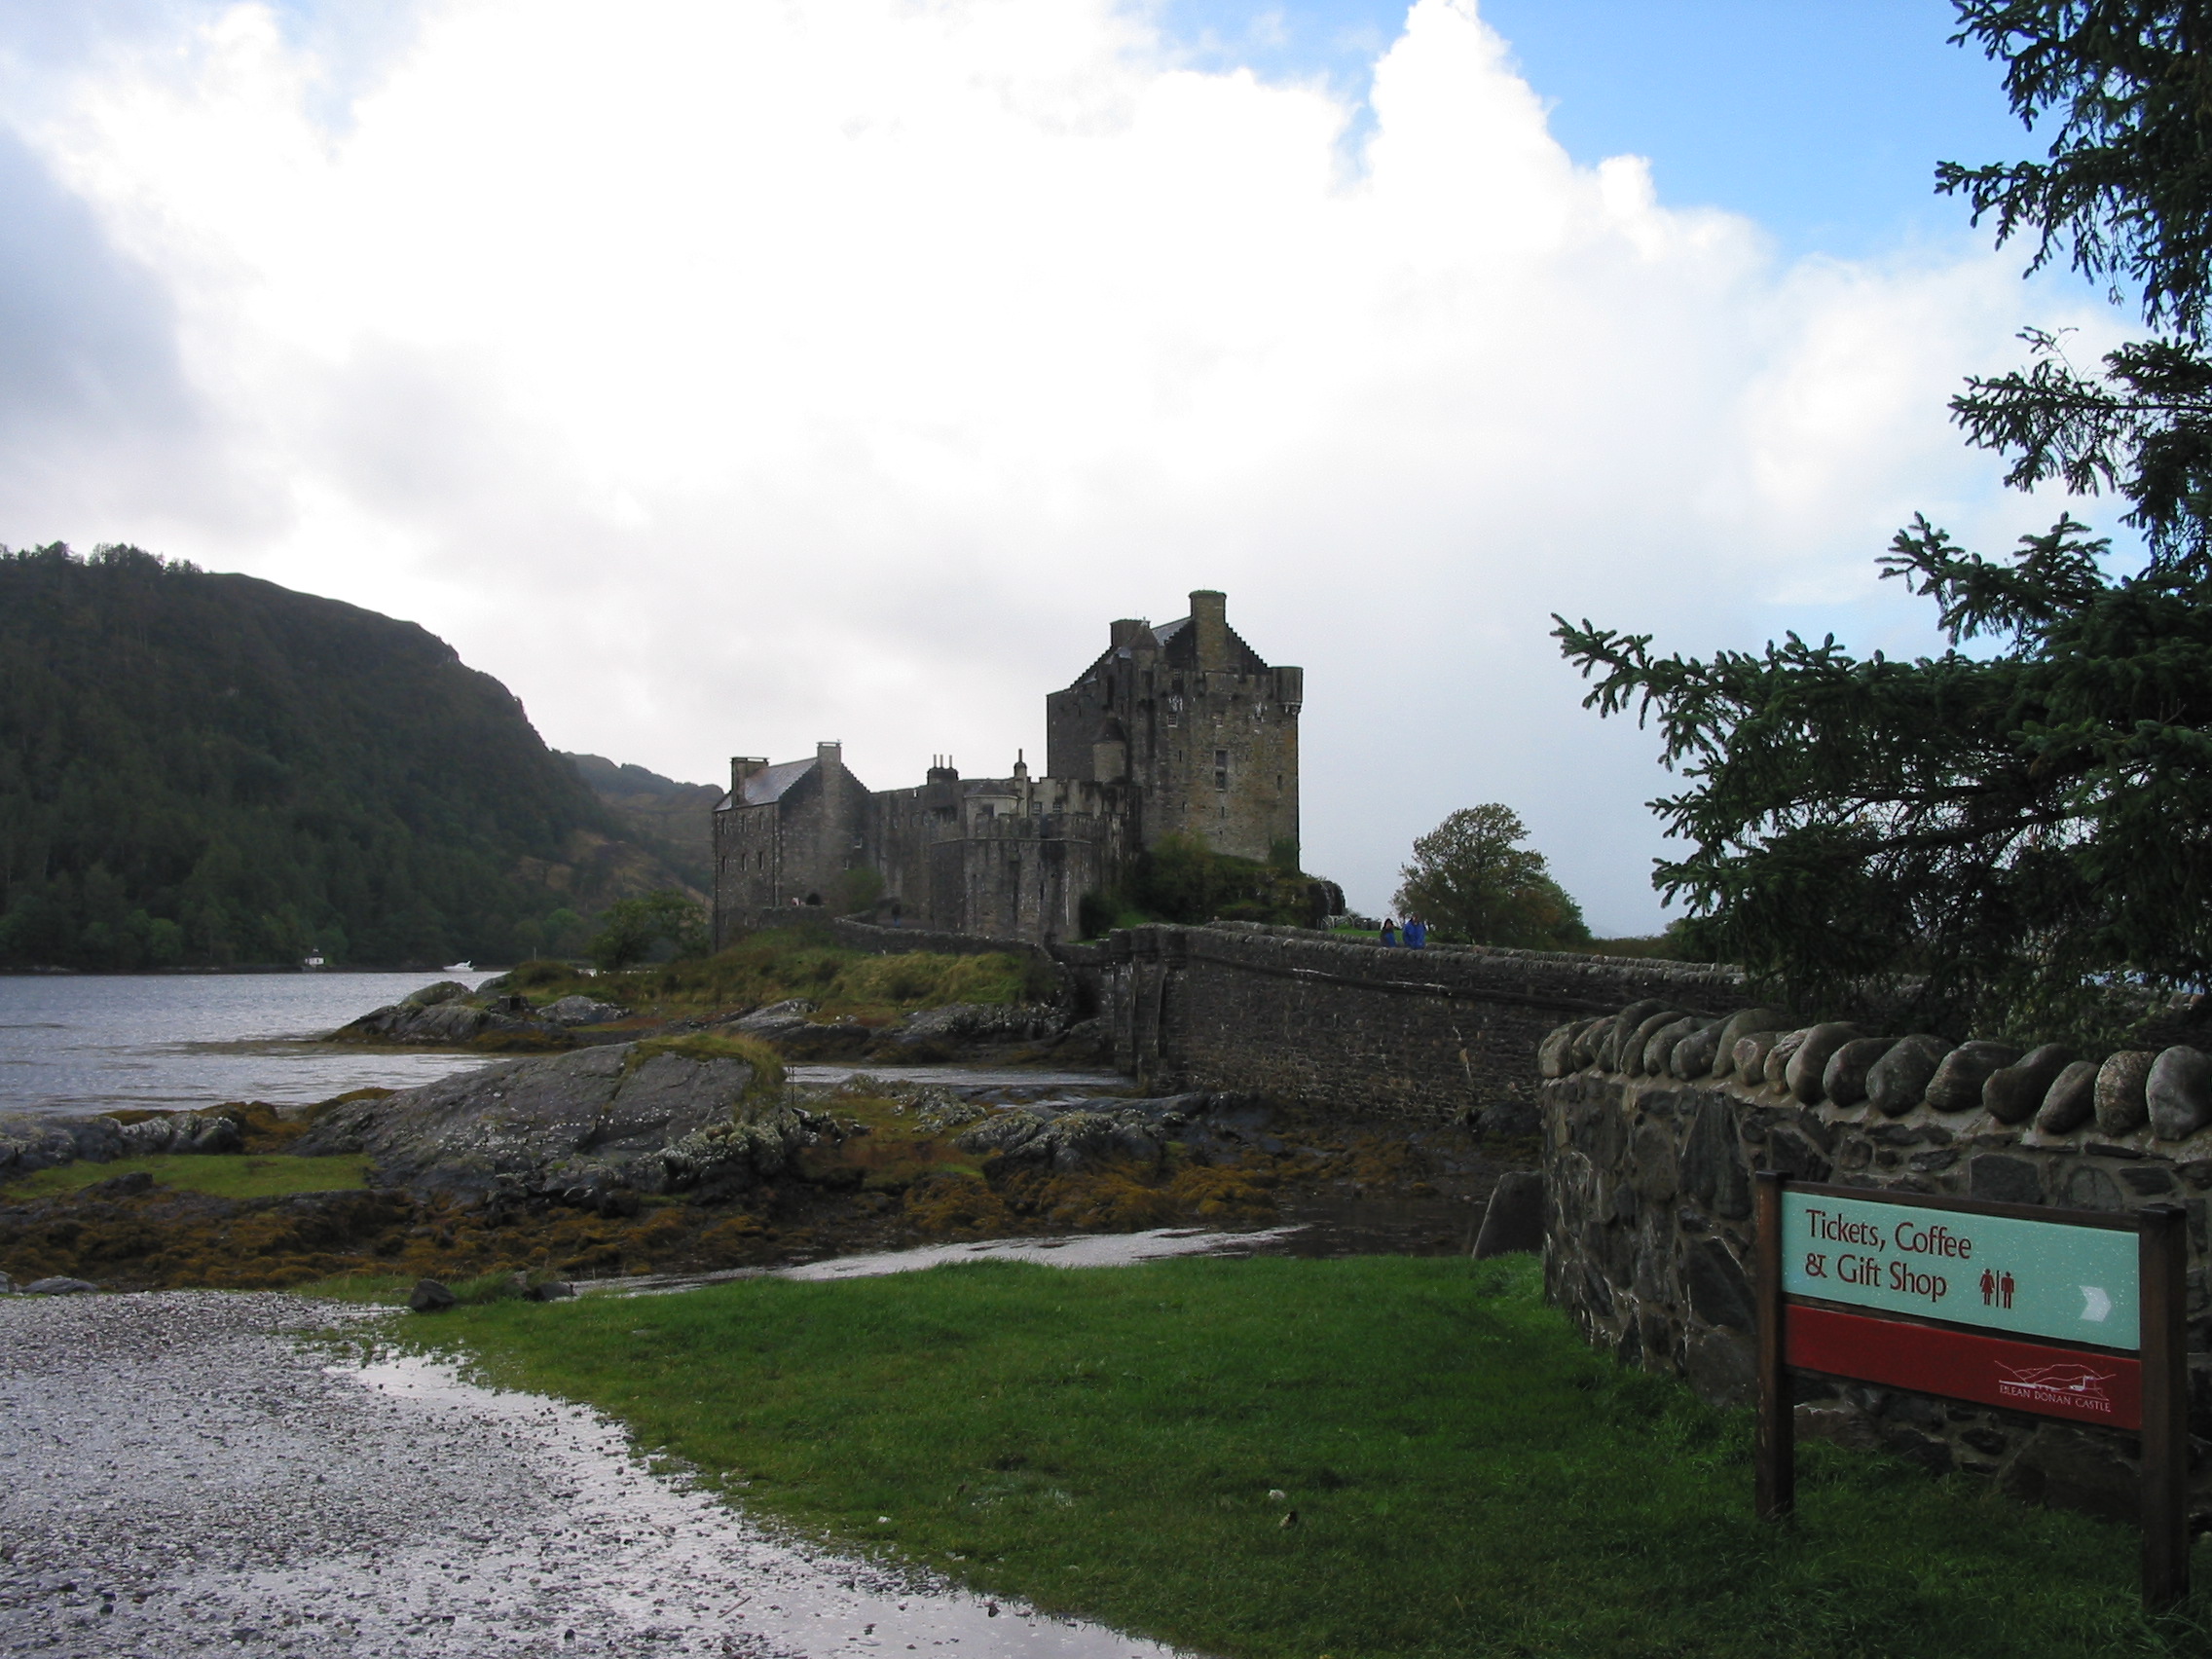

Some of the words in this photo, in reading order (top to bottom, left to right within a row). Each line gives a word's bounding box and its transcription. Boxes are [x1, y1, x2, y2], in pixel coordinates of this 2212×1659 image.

[1805, 1208, 1886, 1252] Tickets,
[1895, 1221, 1972, 1259] Coffee
[1805, 1252, 1827, 1278] &
[1837, 1253, 1882, 1287] Gift
[1889, 1261, 1947, 1303] Shop
[1999, 1384, 2031, 1398] EILEAN
[2034, 1390, 2071, 1406] DONAN
[2075, 1398, 2111, 1413] CASTLE
